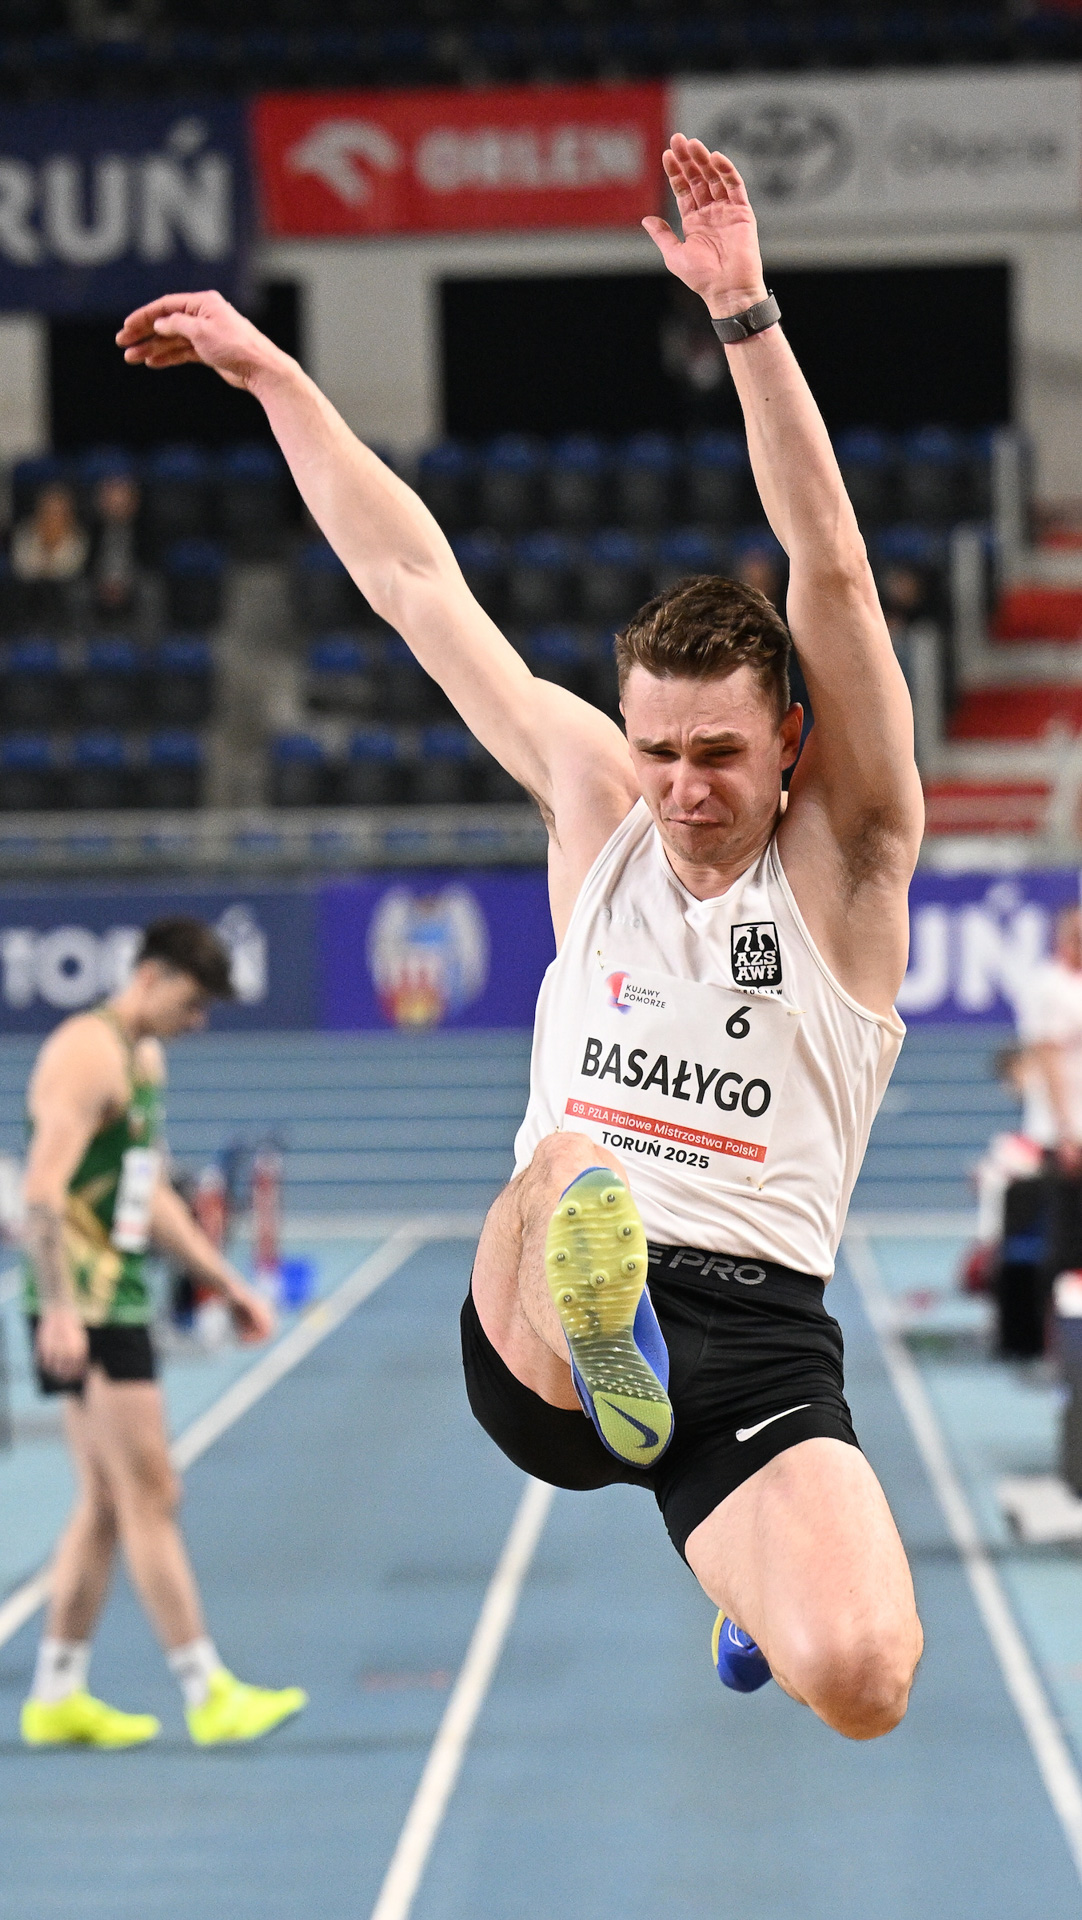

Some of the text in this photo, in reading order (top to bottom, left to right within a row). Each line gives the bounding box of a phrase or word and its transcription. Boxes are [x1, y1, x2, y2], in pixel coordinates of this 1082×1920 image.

[415, 127, 645, 193] ORLEN
[735, 950, 776, 967] AZS
[735, 965, 778, 981] AWF
[623, 992, 666, 1009] POMORZE
[625, 984, 661, 998] KUJAWY
[725, 1005, 752, 1039] 6
[580, 1037, 772, 1118] BASAŁYGO
[572, 1102, 760, 1159] 69. PZLA Halowe Mistrzostwa Polski
[602, 1131, 710, 1169] TORUŃ 2025
[668, 1249, 767, 1285] PRO
